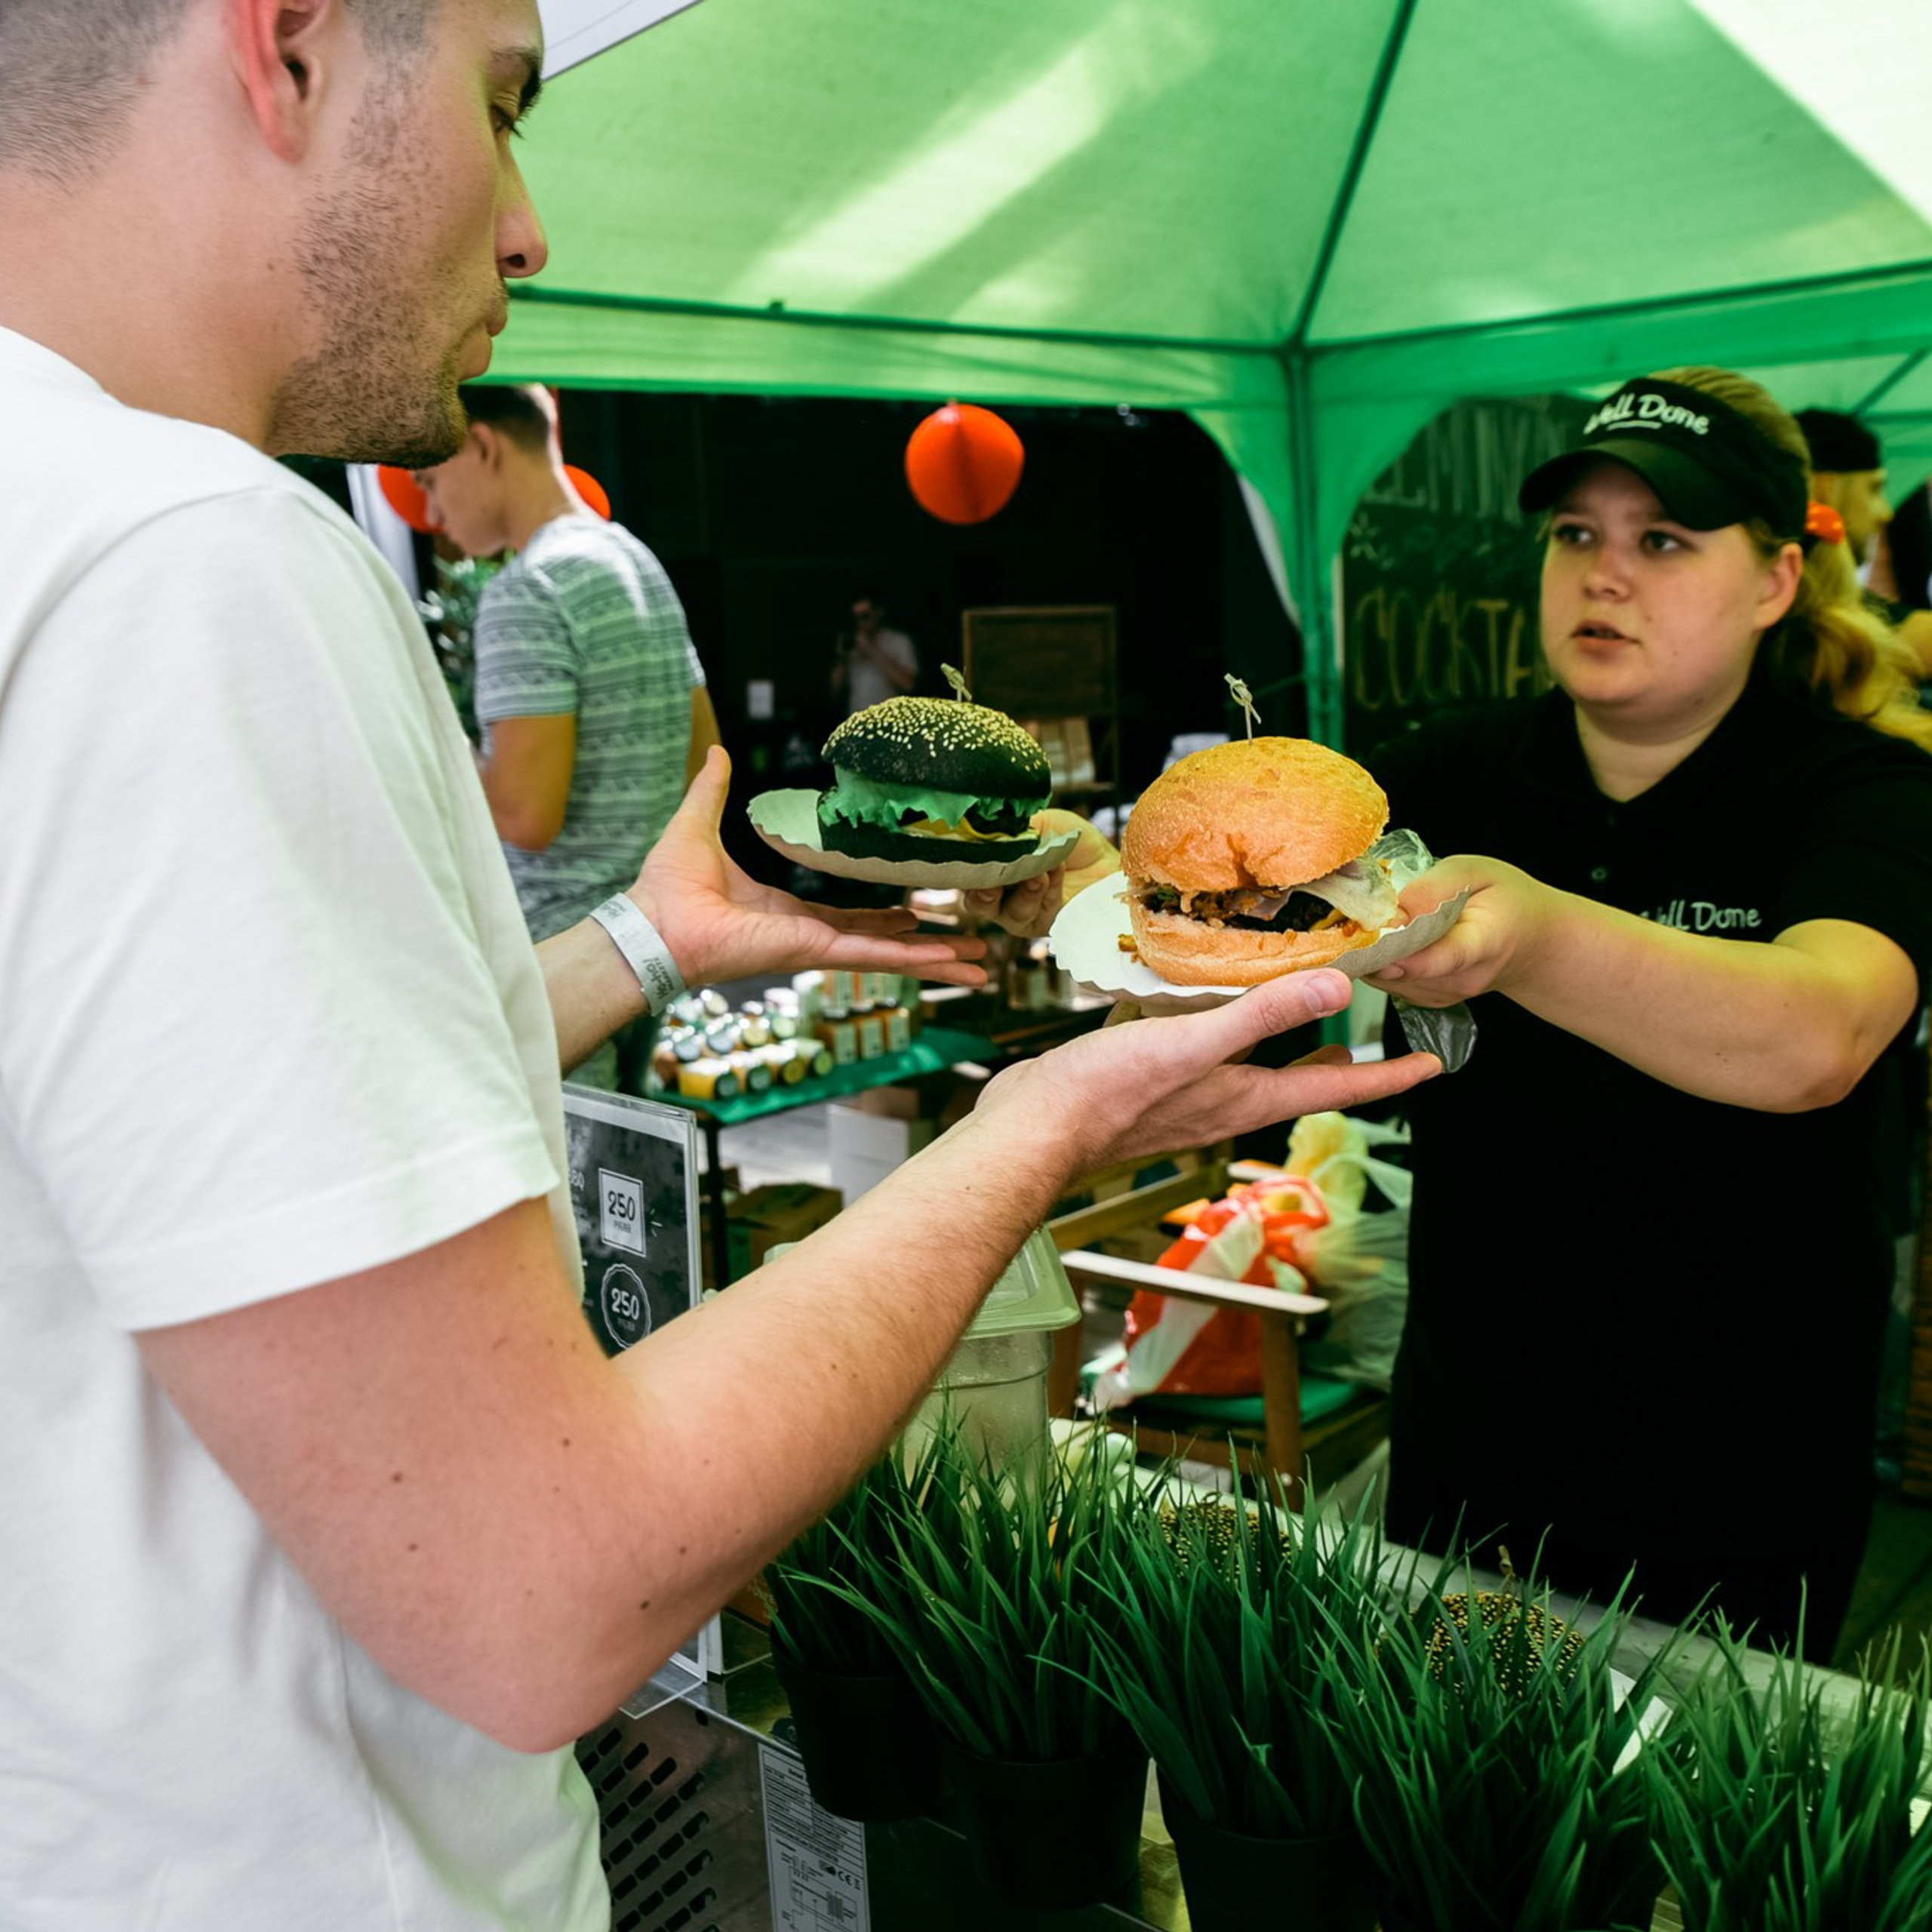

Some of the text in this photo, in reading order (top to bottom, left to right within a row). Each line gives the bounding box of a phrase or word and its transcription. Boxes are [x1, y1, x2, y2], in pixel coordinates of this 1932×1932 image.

[1638, 393, 1709, 435] Done
[1690, 901, 1762, 931] Done
[608, 1190, 635, 1222] 250
[611, 1287, 640, 1321] 250
